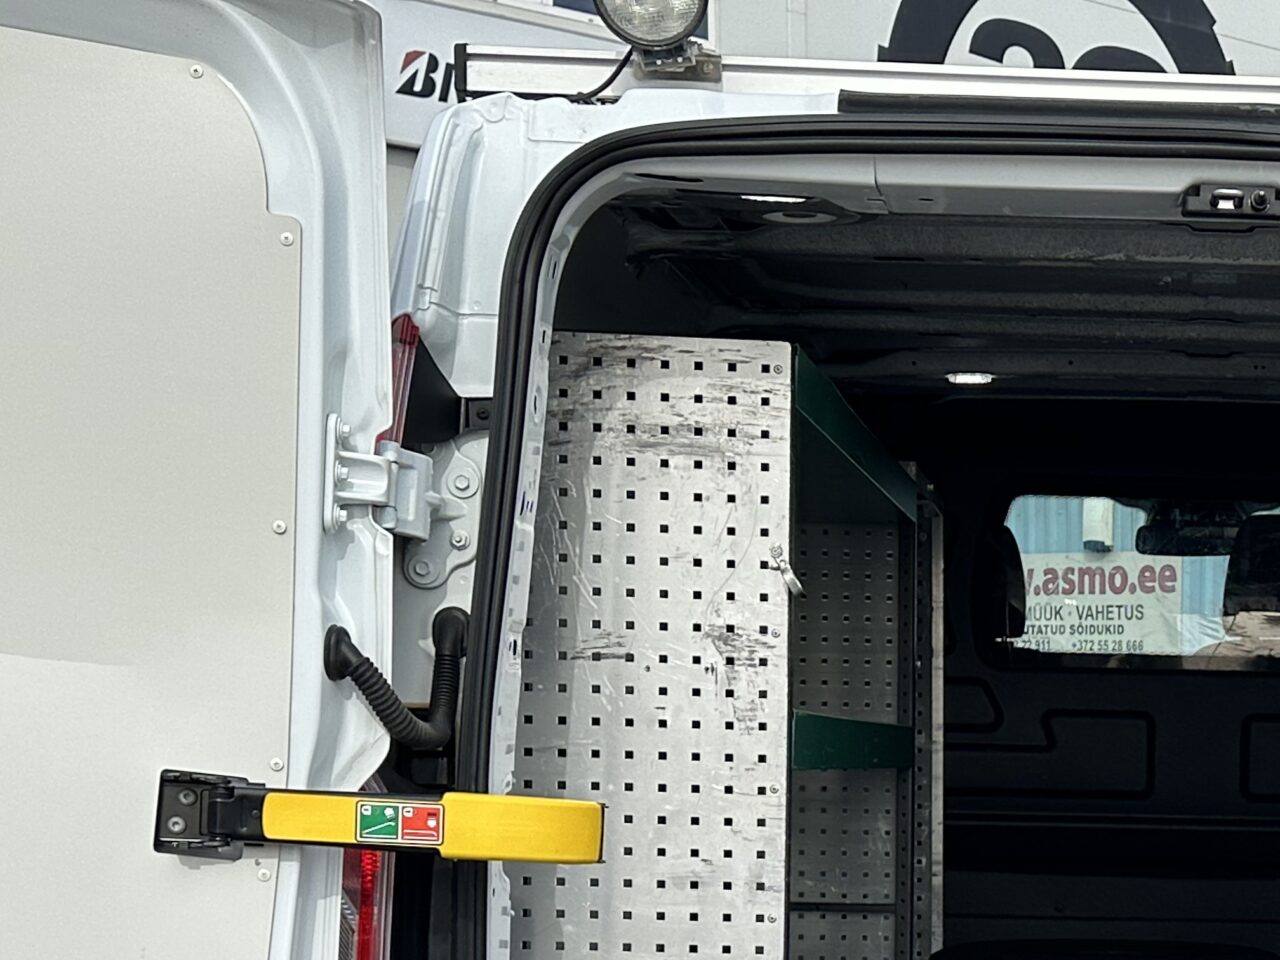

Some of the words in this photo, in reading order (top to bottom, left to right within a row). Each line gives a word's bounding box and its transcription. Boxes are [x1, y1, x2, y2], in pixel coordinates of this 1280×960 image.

[1076, 604, 1144, 621] VAHETUS
[1072, 639, 1095, 651] +372
[1097, 639, 1109, 651] 55
[1111, 639, 1123, 651] 28
[1126, 639, 1144, 651] 666
